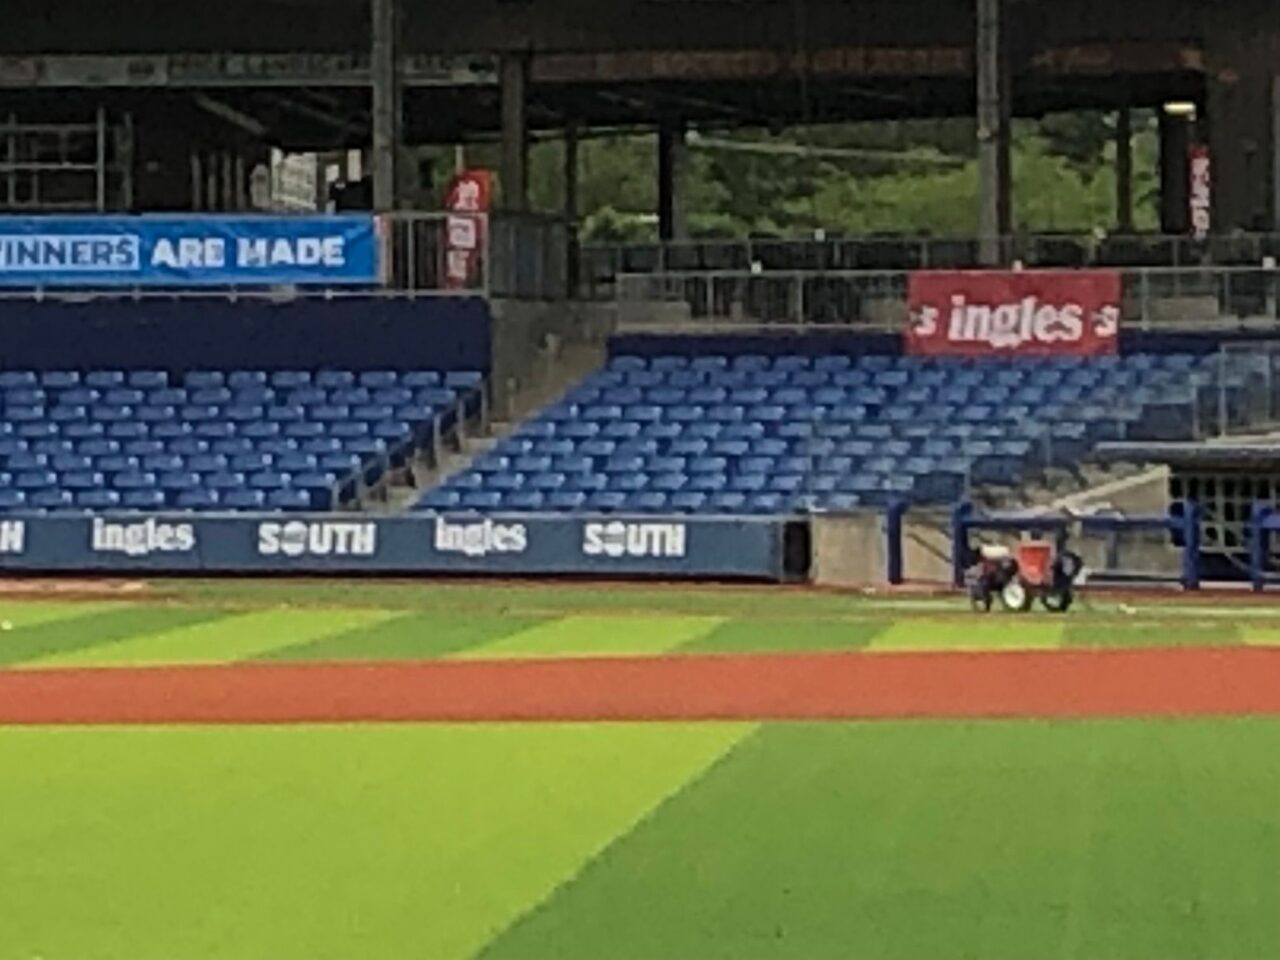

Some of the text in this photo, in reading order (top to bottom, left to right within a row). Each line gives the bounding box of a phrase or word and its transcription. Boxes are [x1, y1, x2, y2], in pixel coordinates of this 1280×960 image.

[151, 238, 225, 267] ARE
[237, 236, 345, 266] MADE
[948, 295, 1083, 347] ingles
[92, 517, 195, 554] ingles
[258, 521, 376, 556] SOUTH
[434, 517, 528, 555] ingles
[583, 521, 686, 557] SOUTH
